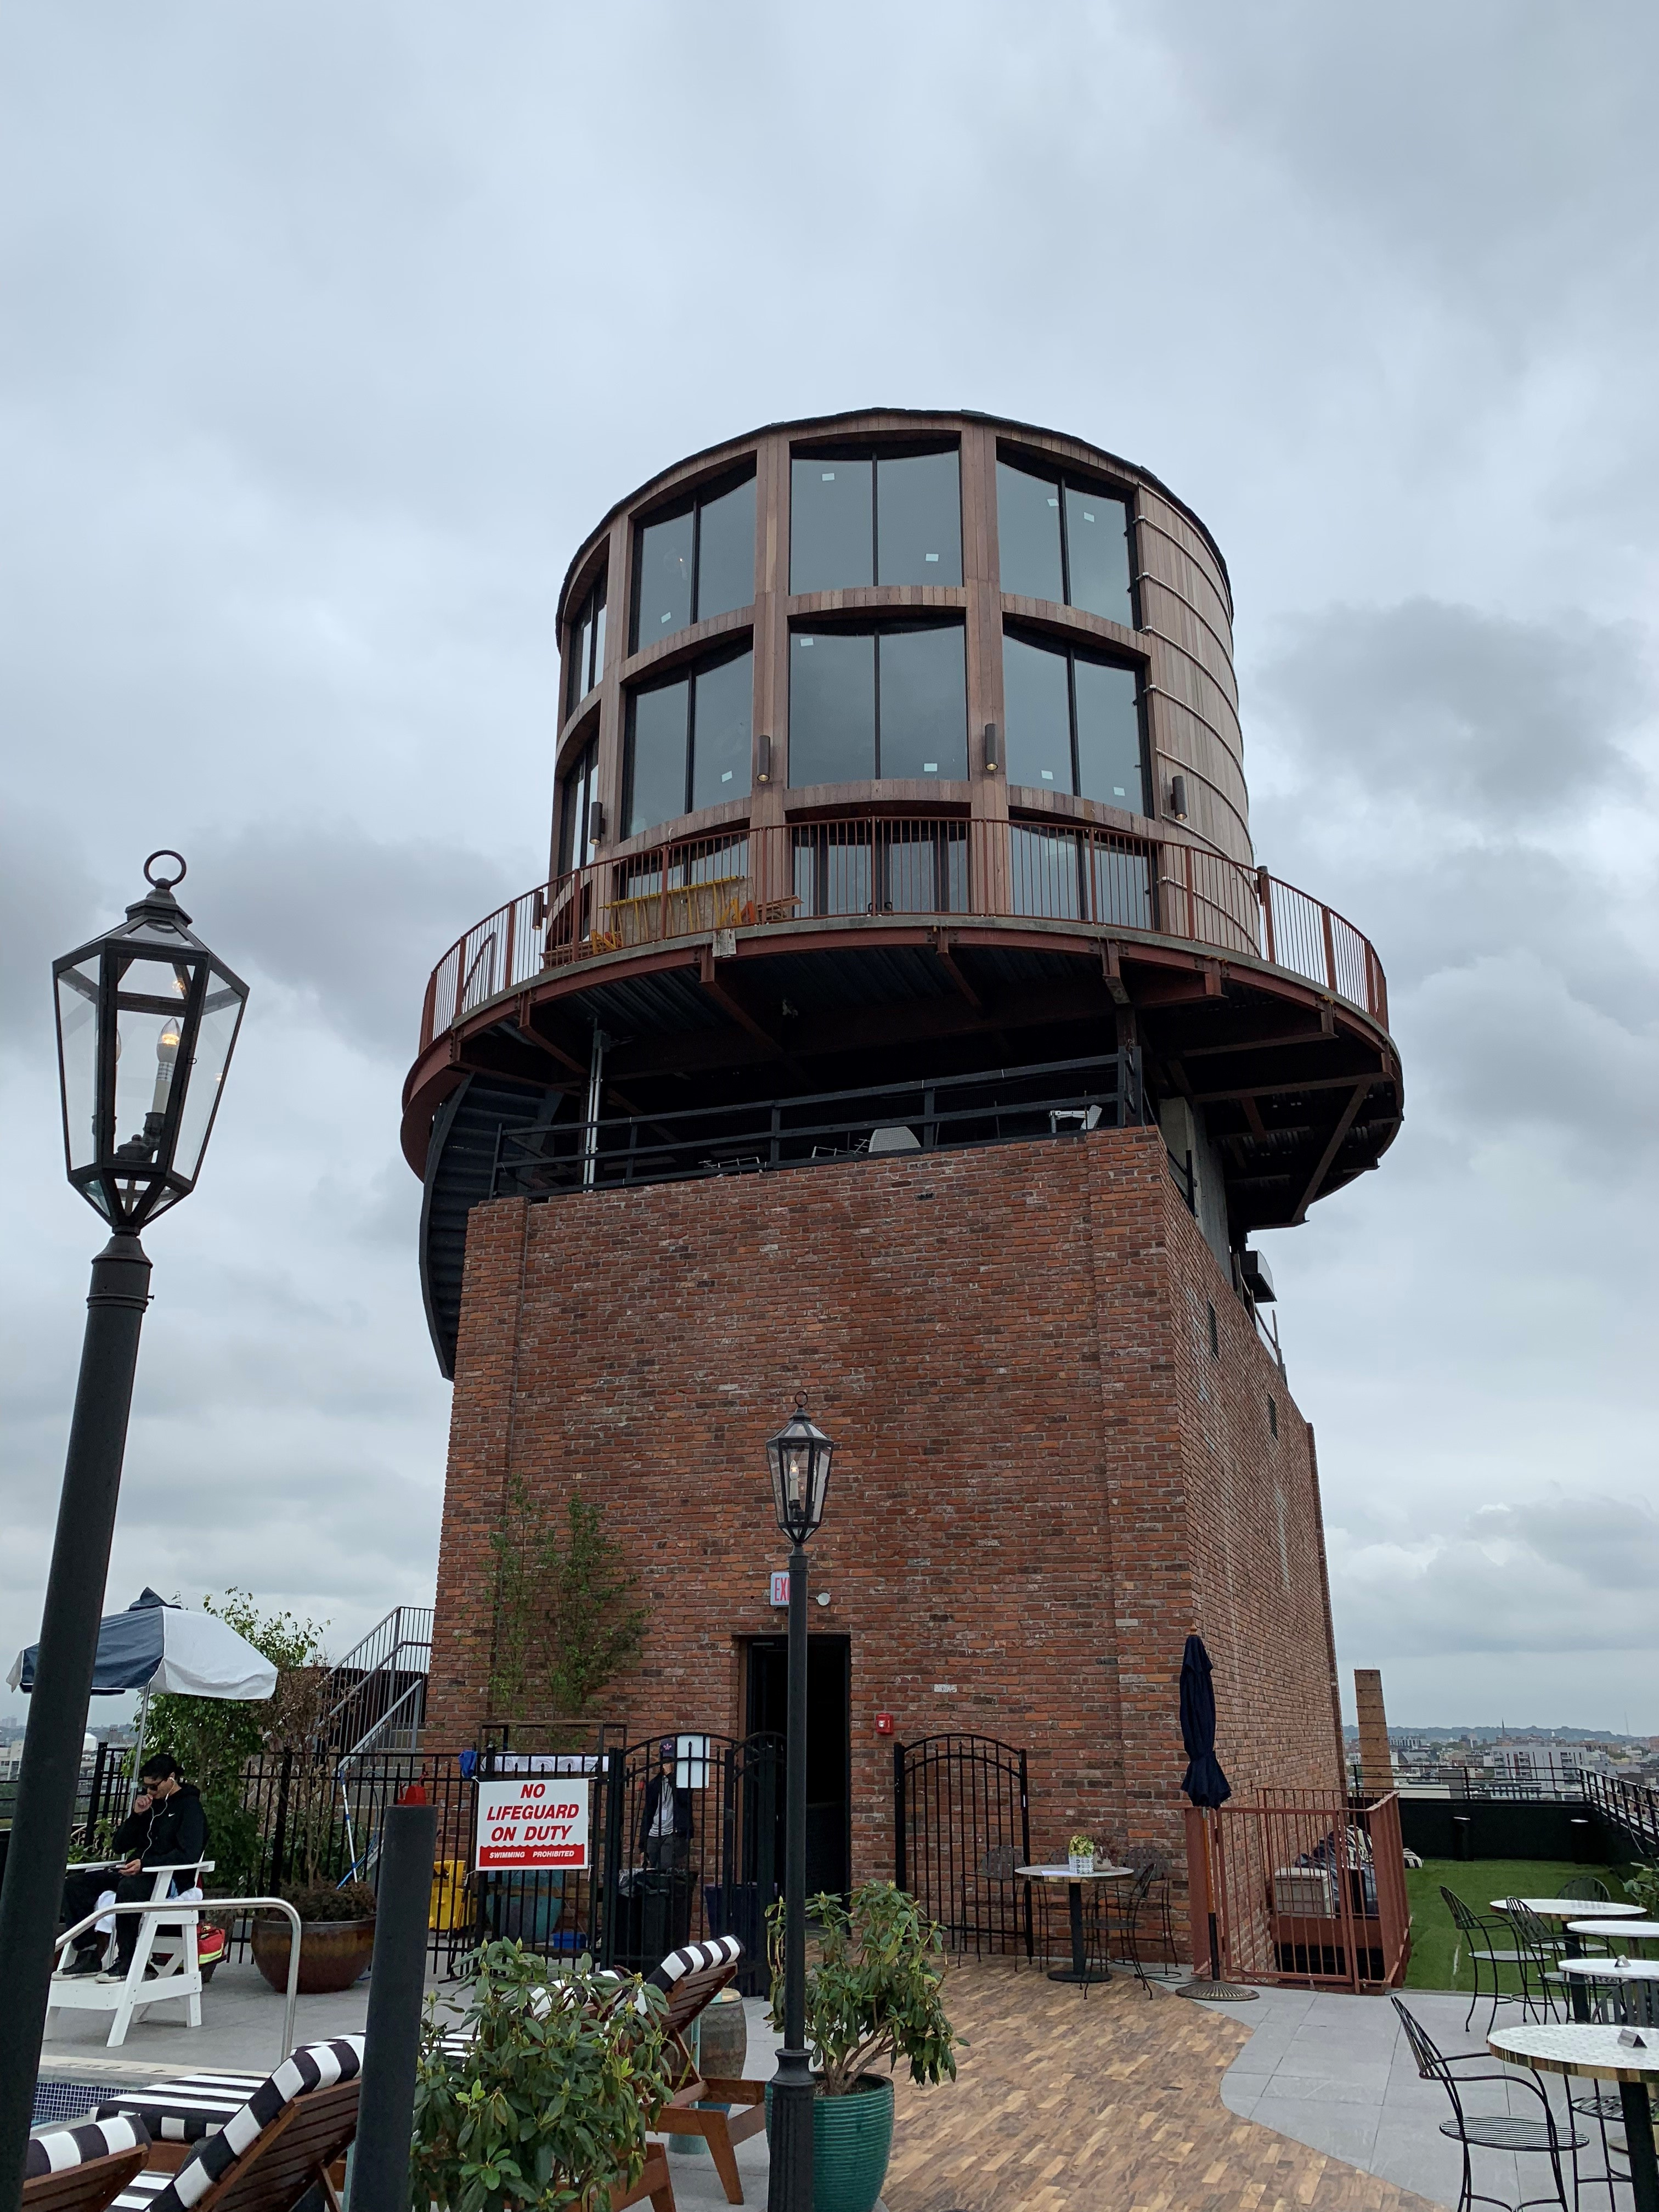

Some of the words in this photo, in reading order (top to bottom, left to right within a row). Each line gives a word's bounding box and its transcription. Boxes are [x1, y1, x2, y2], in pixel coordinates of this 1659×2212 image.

[774, 1577, 790, 1601] EXI
[520, 1783, 546, 1799] NO
[487, 1804, 579, 1821] LIFEGUARD
[491, 1826, 517, 1842] ON
[523, 1825, 573, 1841] DUTY
